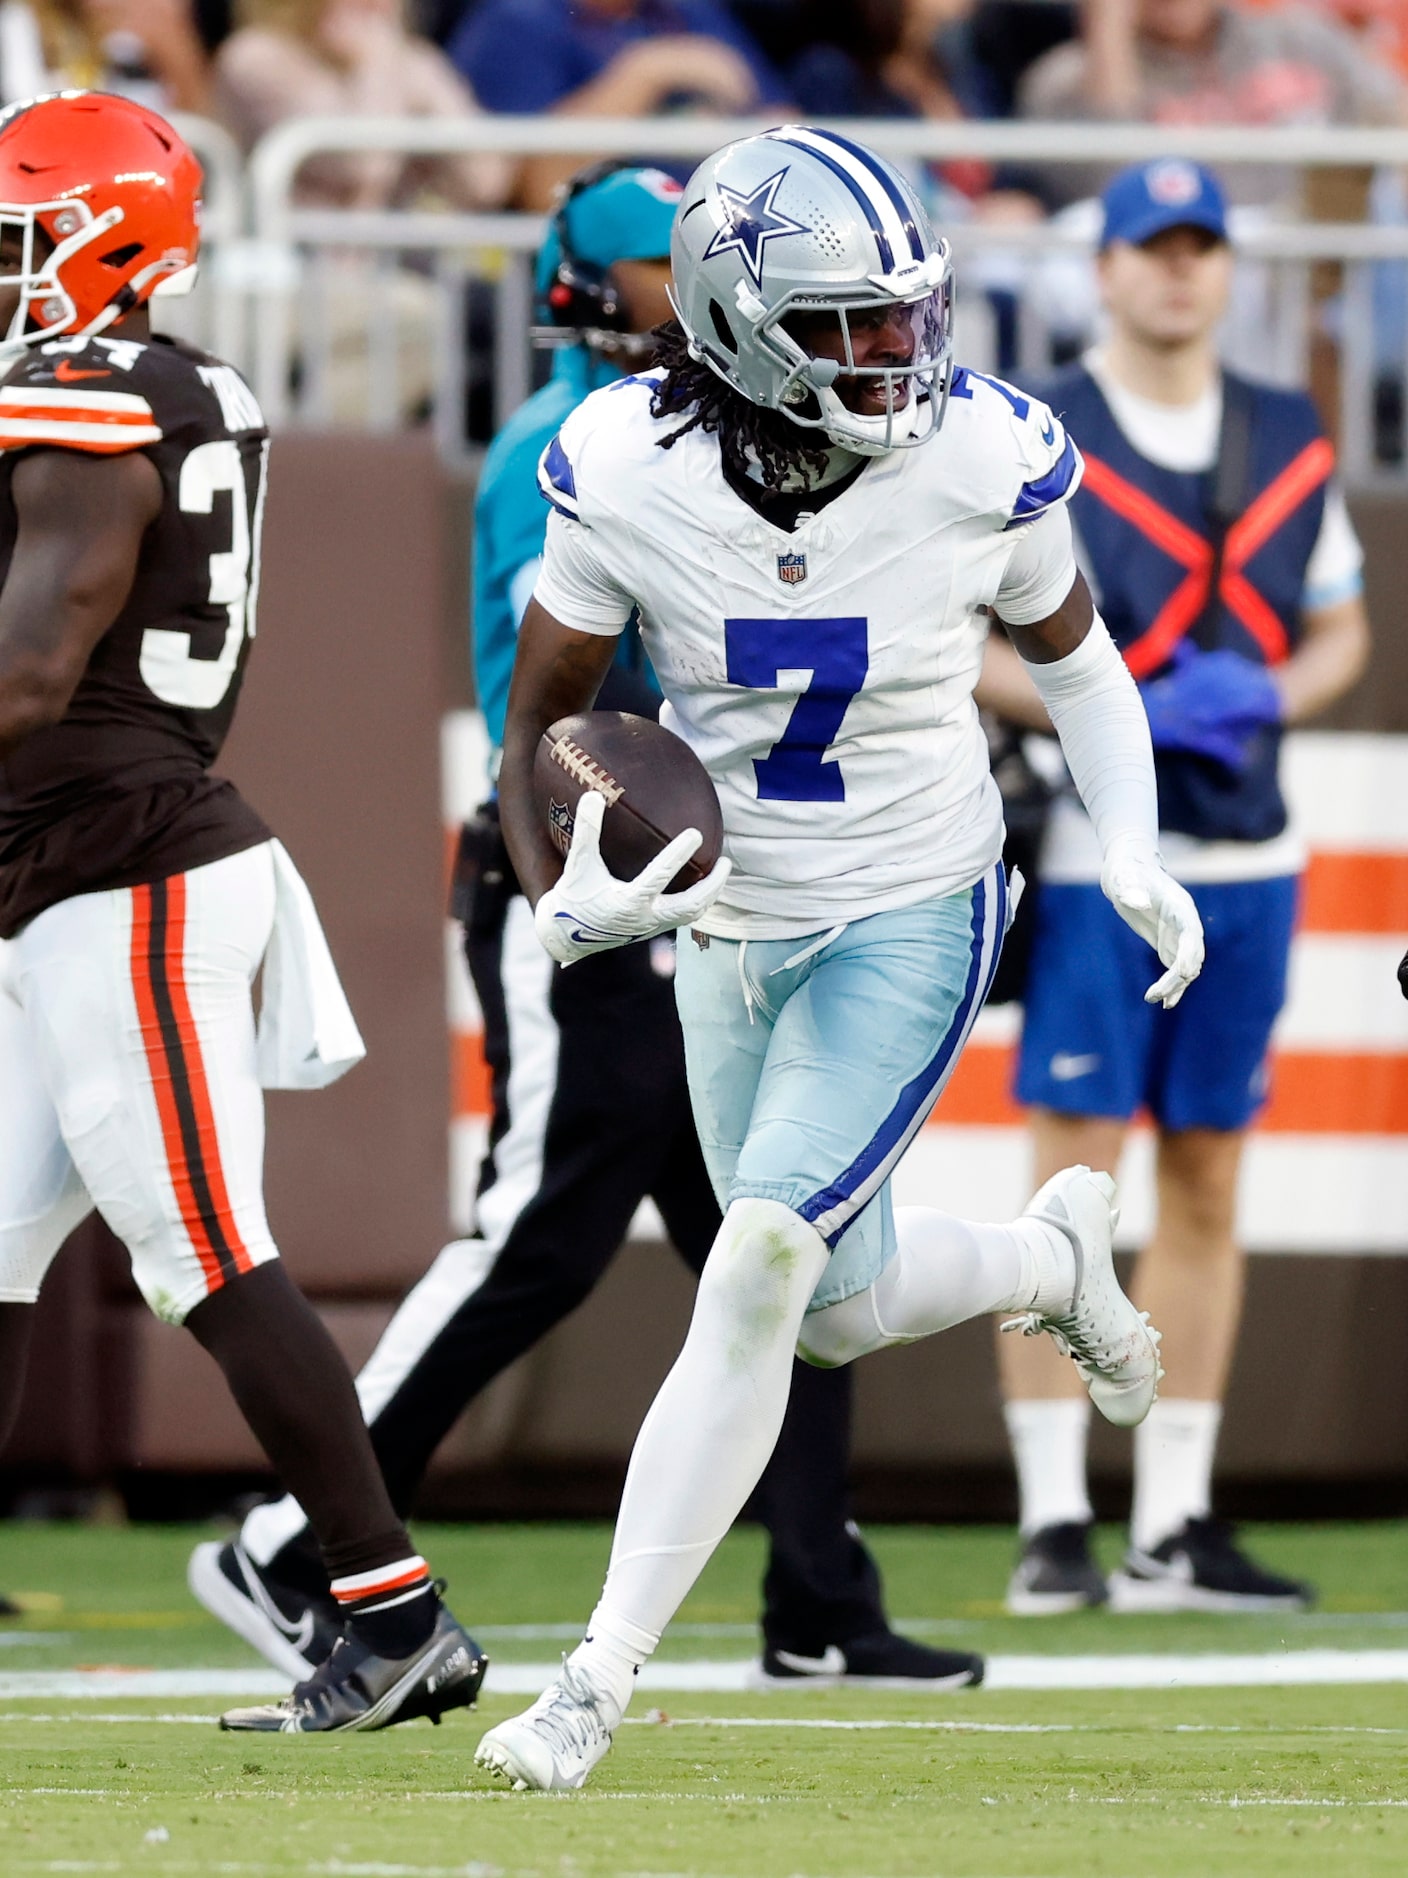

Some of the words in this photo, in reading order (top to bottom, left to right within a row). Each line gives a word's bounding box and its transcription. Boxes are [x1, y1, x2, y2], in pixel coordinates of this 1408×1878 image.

[139, 438, 272, 710] 3
[782, 565, 804, 581] NFL
[724, 616, 869, 803] 7
